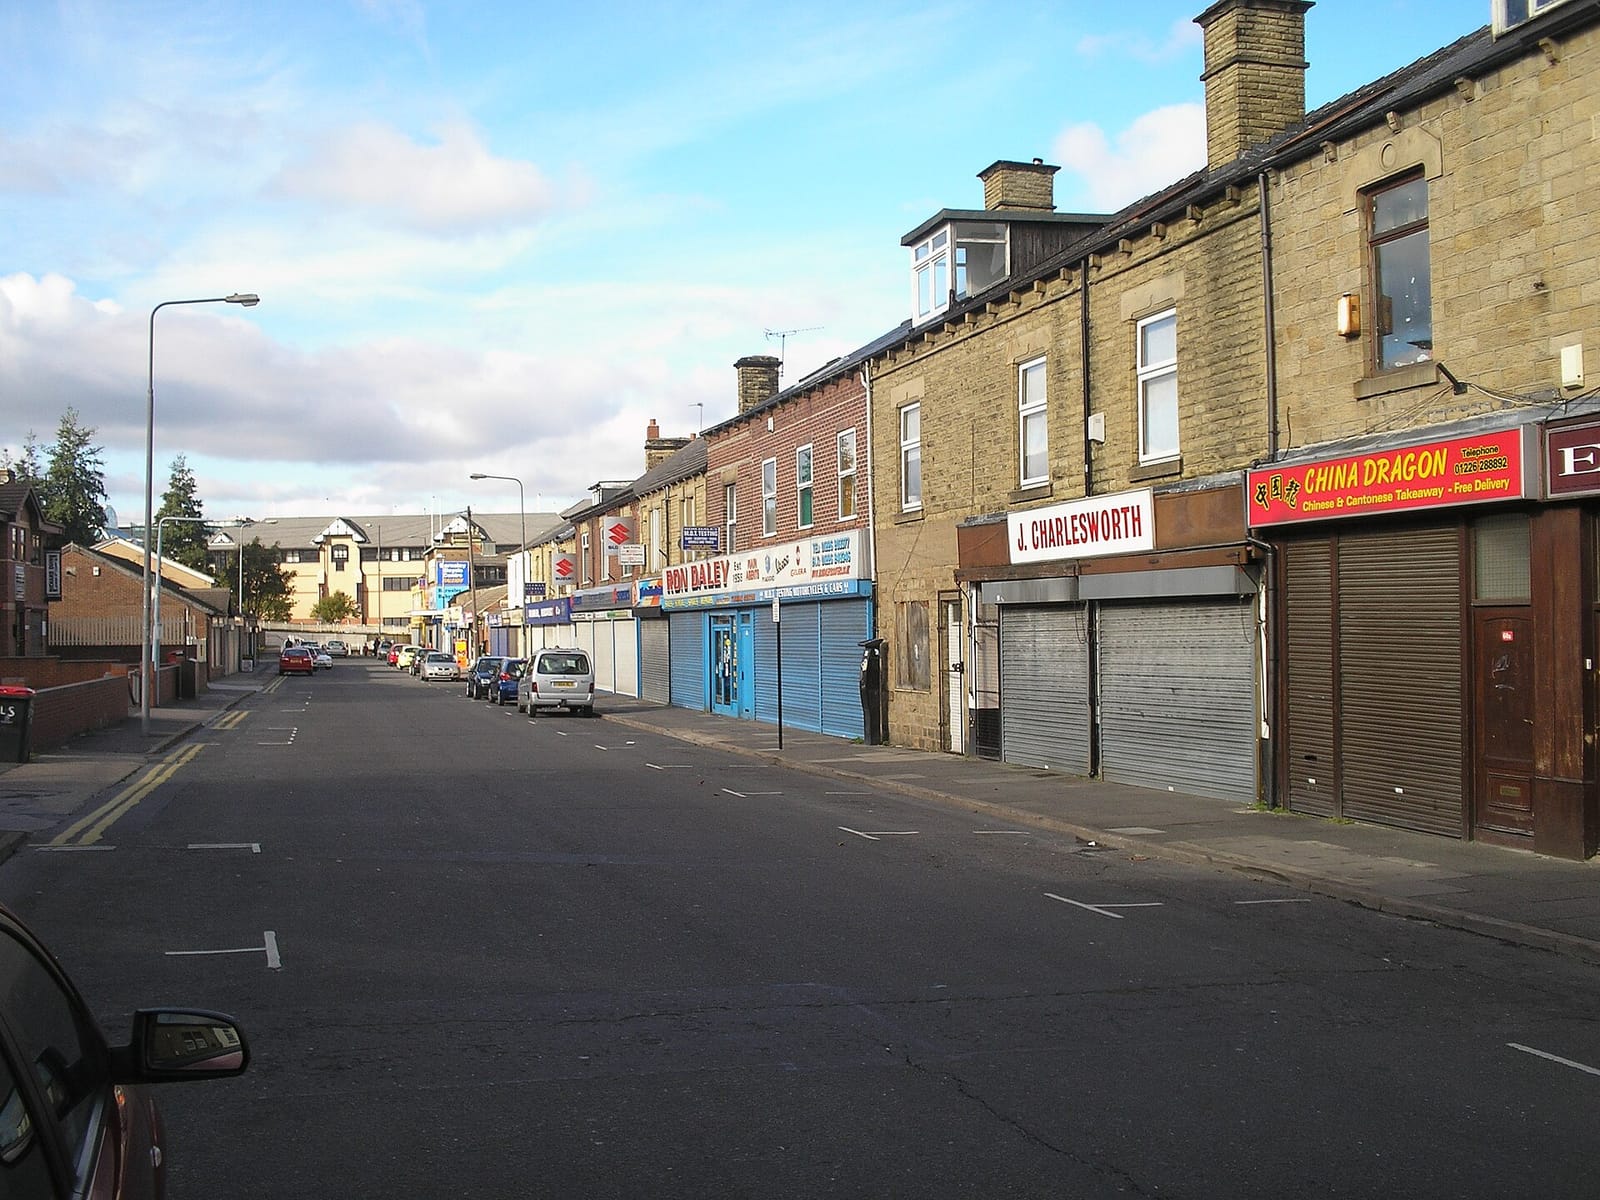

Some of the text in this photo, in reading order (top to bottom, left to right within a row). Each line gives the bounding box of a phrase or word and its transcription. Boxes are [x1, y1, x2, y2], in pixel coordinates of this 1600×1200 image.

[1454, 457, 1508, 475] 01226 288892
[1462, 445, 1499, 458] Telephone
[1304, 447, 1448, 494] CHINA DRAGON
[1302, 499, 1335, 512] Chinese
[1337, 496, 1345, 508] &
[1346, 492, 1393, 506] Cantonese
[1395, 486, 1444, 501] Takeaway
[1454, 481, 1473, 494] Free
[1475, 477, 1510, 491] Delivery
[1018, 505, 1142, 552] J. CHARLESWORTH
[666, 567, 689, 595] RON
[691, 559, 730, 592] DALEY
